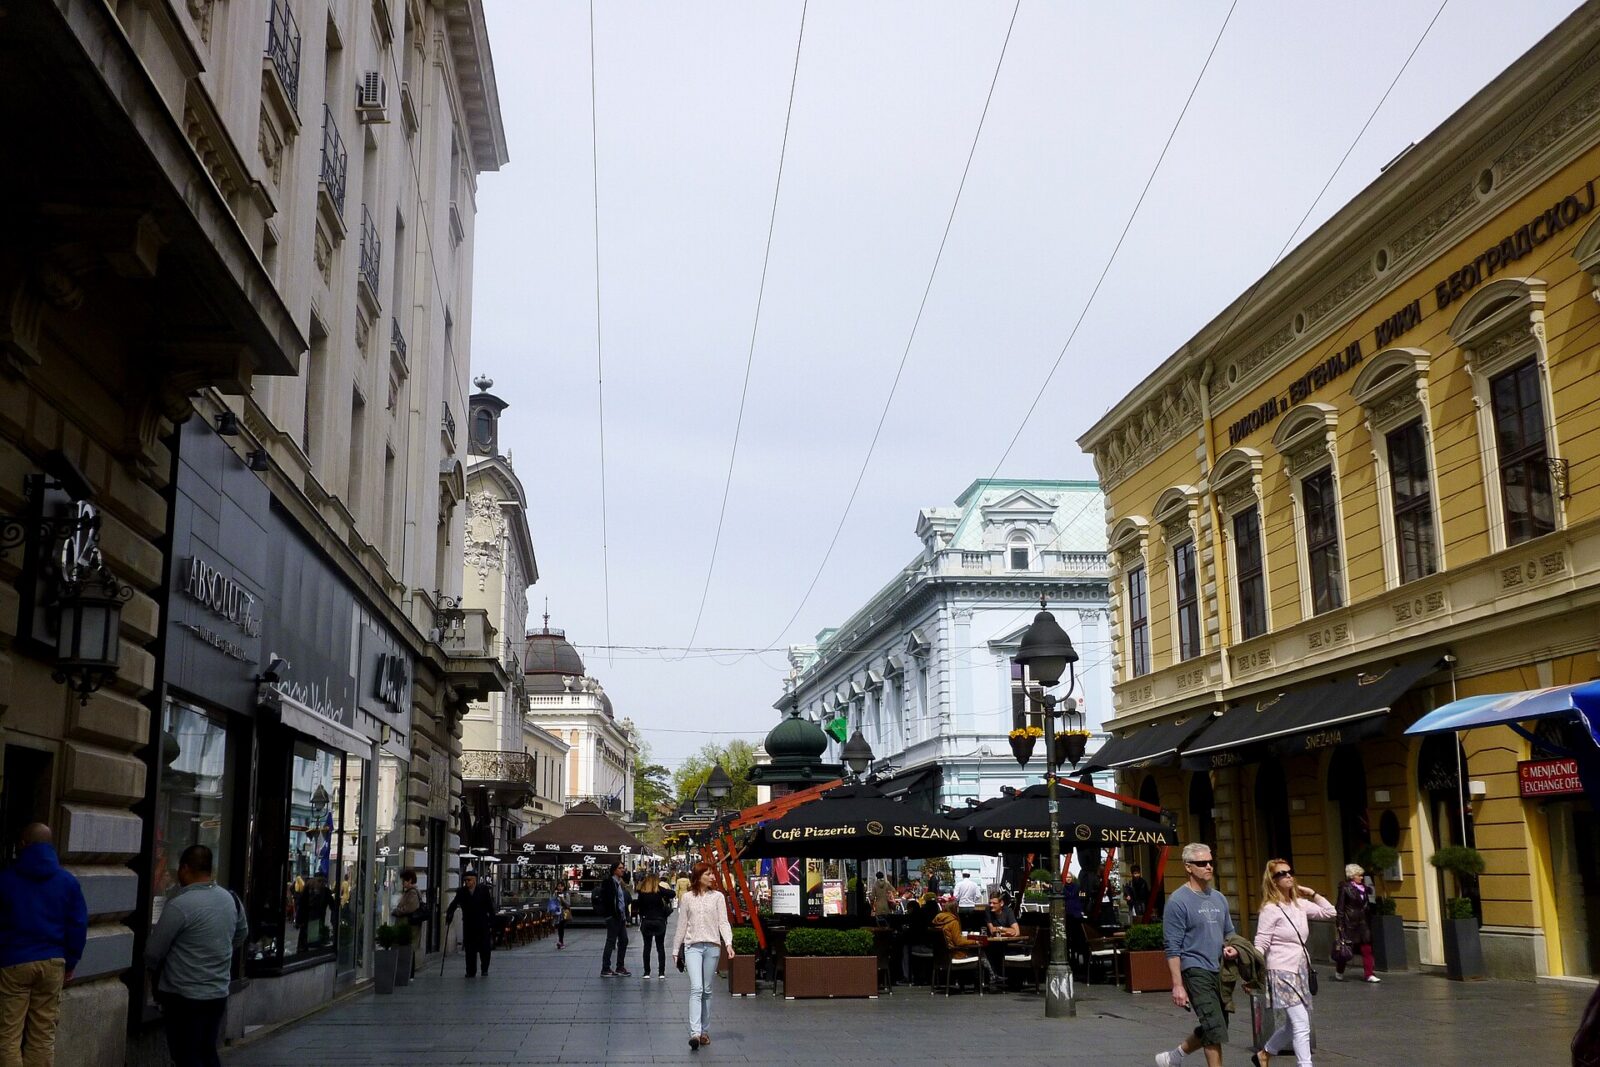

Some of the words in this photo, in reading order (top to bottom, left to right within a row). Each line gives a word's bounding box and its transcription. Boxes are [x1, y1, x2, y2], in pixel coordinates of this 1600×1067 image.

[1228, 396, 1280, 446] НИКОЛА
[1375, 298, 1422, 350] КИКИ
[1435, 180, 1596, 310] БЕОГРАДСКОЈ
[1524, 778, 1564, 792] EXCHANGE
[772, 827, 801, 840] Café
[803, 824, 857, 837] Pizzeria
[893, 824, 961, 841] SNEŽANA
[983, 828, 1011, 840] Café
[1101, 827, 1167, 844] SNEŽANA
